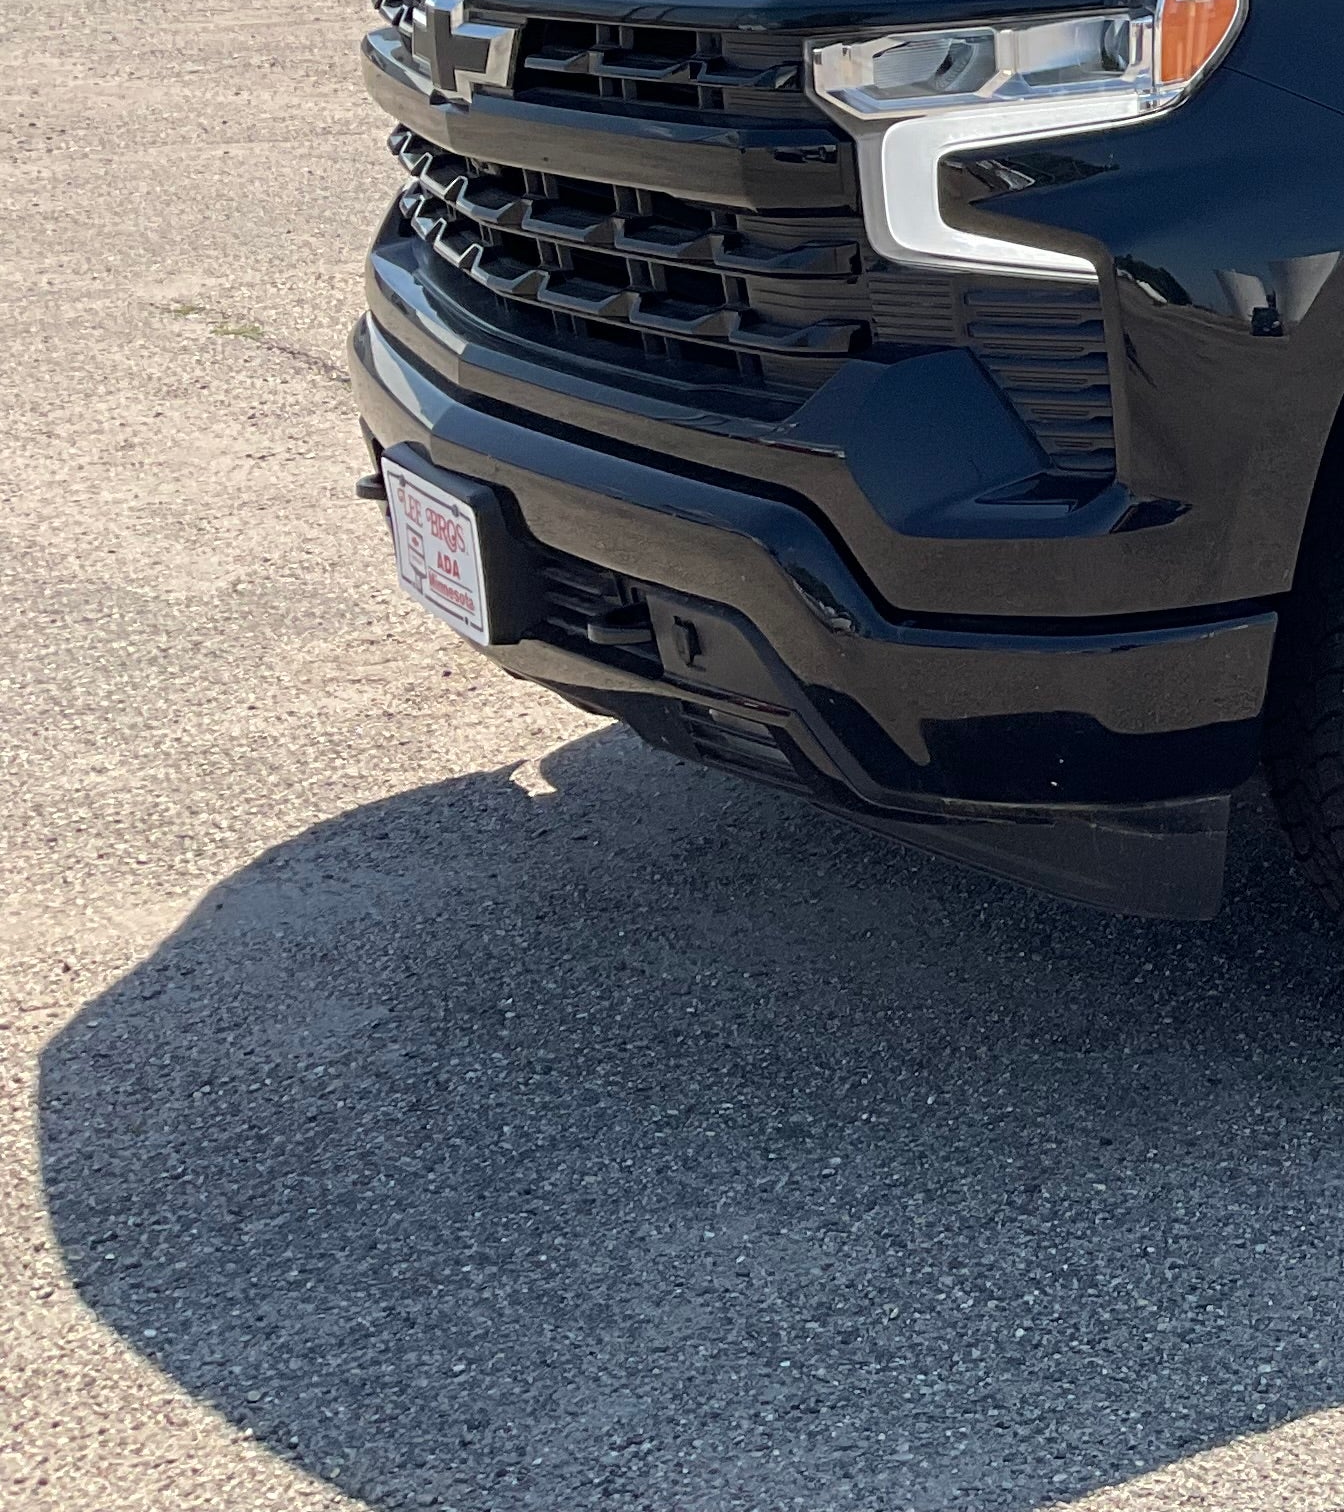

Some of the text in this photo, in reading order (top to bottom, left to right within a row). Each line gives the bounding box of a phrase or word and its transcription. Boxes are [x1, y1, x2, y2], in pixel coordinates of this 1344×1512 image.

[396, 487, 424, 529] LEE
[436, 551, 461, 580] ADA
[429, 570, 476, 612] Minnesota
